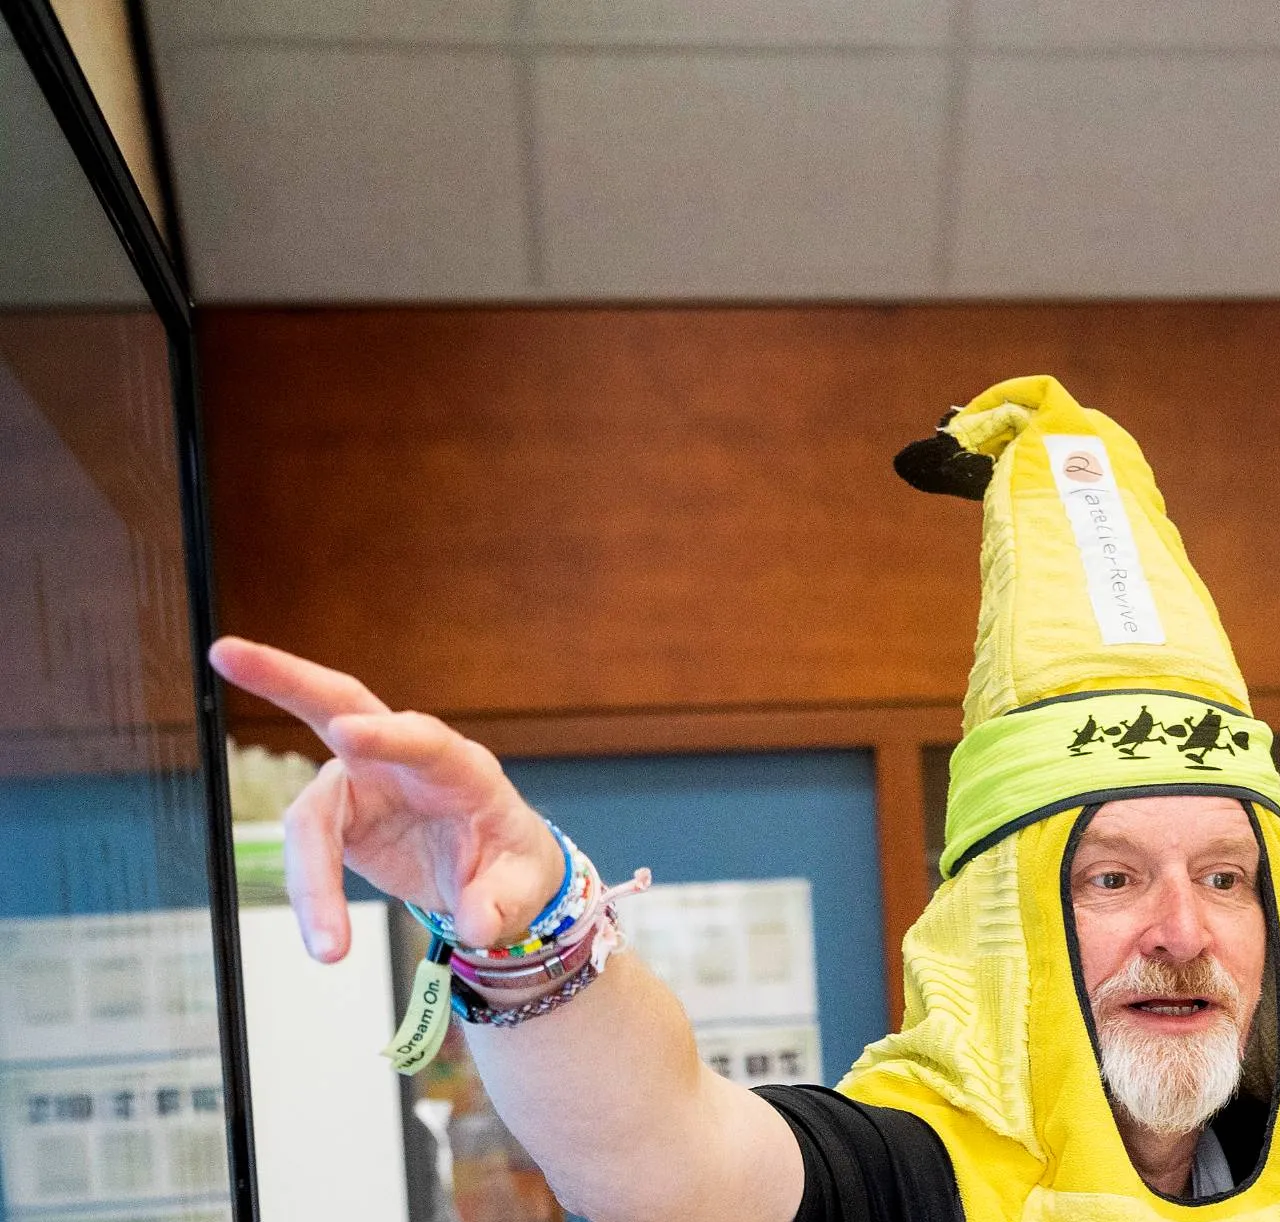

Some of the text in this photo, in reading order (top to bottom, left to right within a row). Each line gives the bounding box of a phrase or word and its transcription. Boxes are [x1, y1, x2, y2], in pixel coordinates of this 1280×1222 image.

[1084, 493, 1138, 633] atelier Revive
[396, 1008, 435, 1055] Dream
[423, 979, 441, 1005] On.
